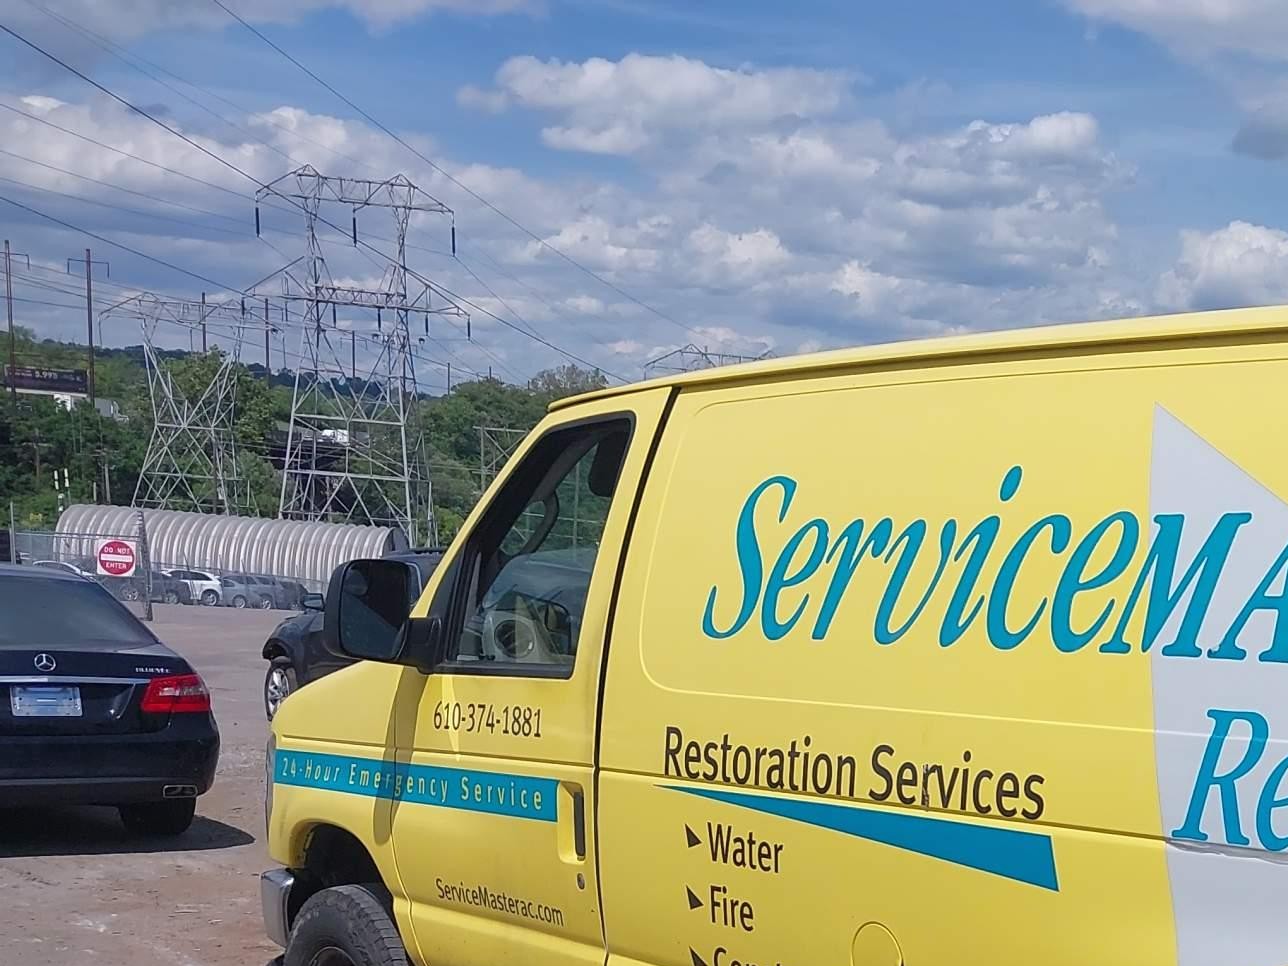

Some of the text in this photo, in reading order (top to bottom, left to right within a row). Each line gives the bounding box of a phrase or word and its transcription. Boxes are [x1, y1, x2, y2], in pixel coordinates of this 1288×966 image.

[433, 700, 542, 738] 610-374-1881
[282, 757, 543, 811] 24-Hour Emergency Service
[664, 726, 1045, 820] Restoration Services
[707, 822, 784, 874] Water
[435, 878, 564, 927] ServiceMasterac.com
[709, 885, 754, 931] Fire
